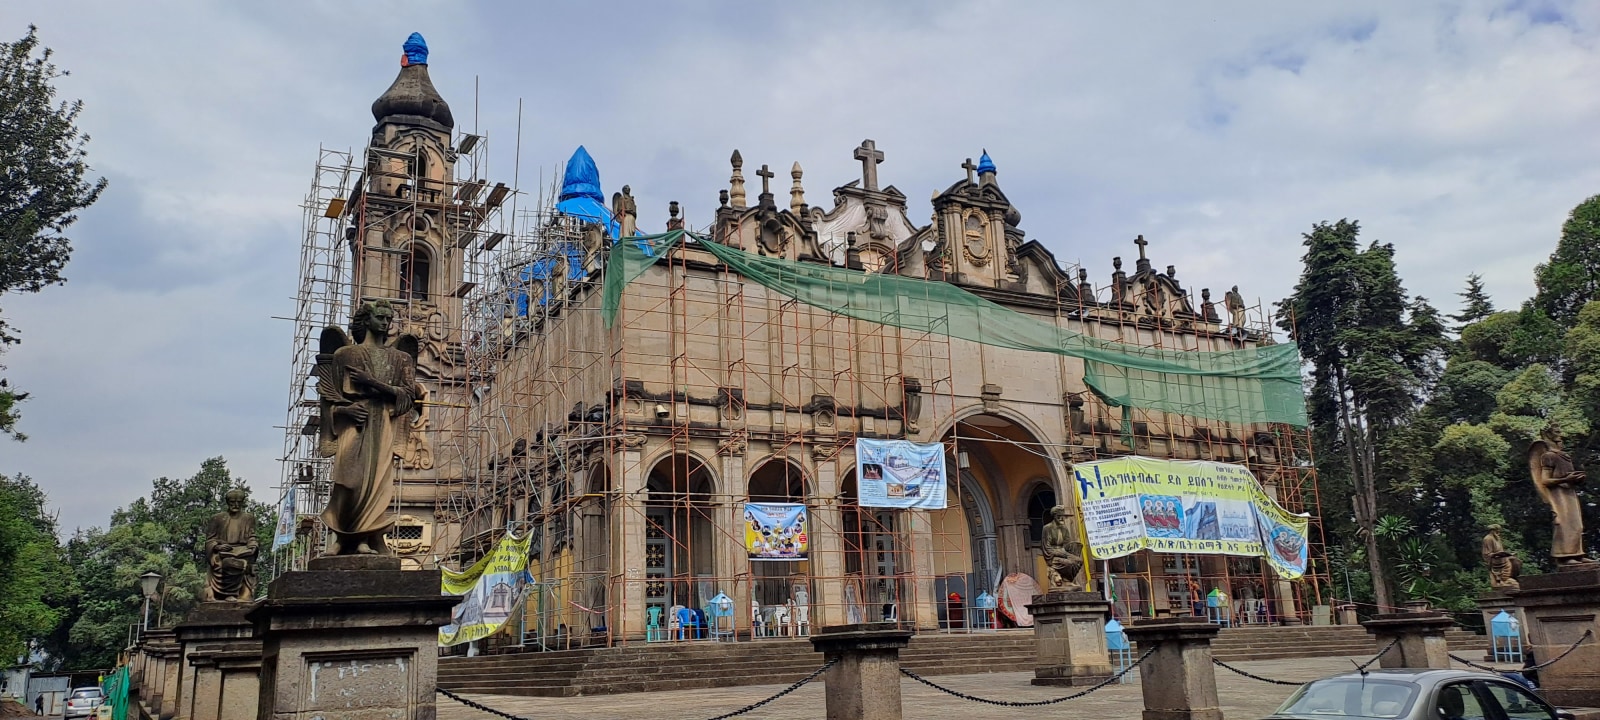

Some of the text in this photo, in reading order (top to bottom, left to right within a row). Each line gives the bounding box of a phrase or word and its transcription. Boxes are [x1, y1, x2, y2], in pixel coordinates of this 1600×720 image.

[1168, 474, 1182, 486] ደስ
[1187, 475, 1214, 488] ይበለን
[1226, 542, 1239, 552] እና
